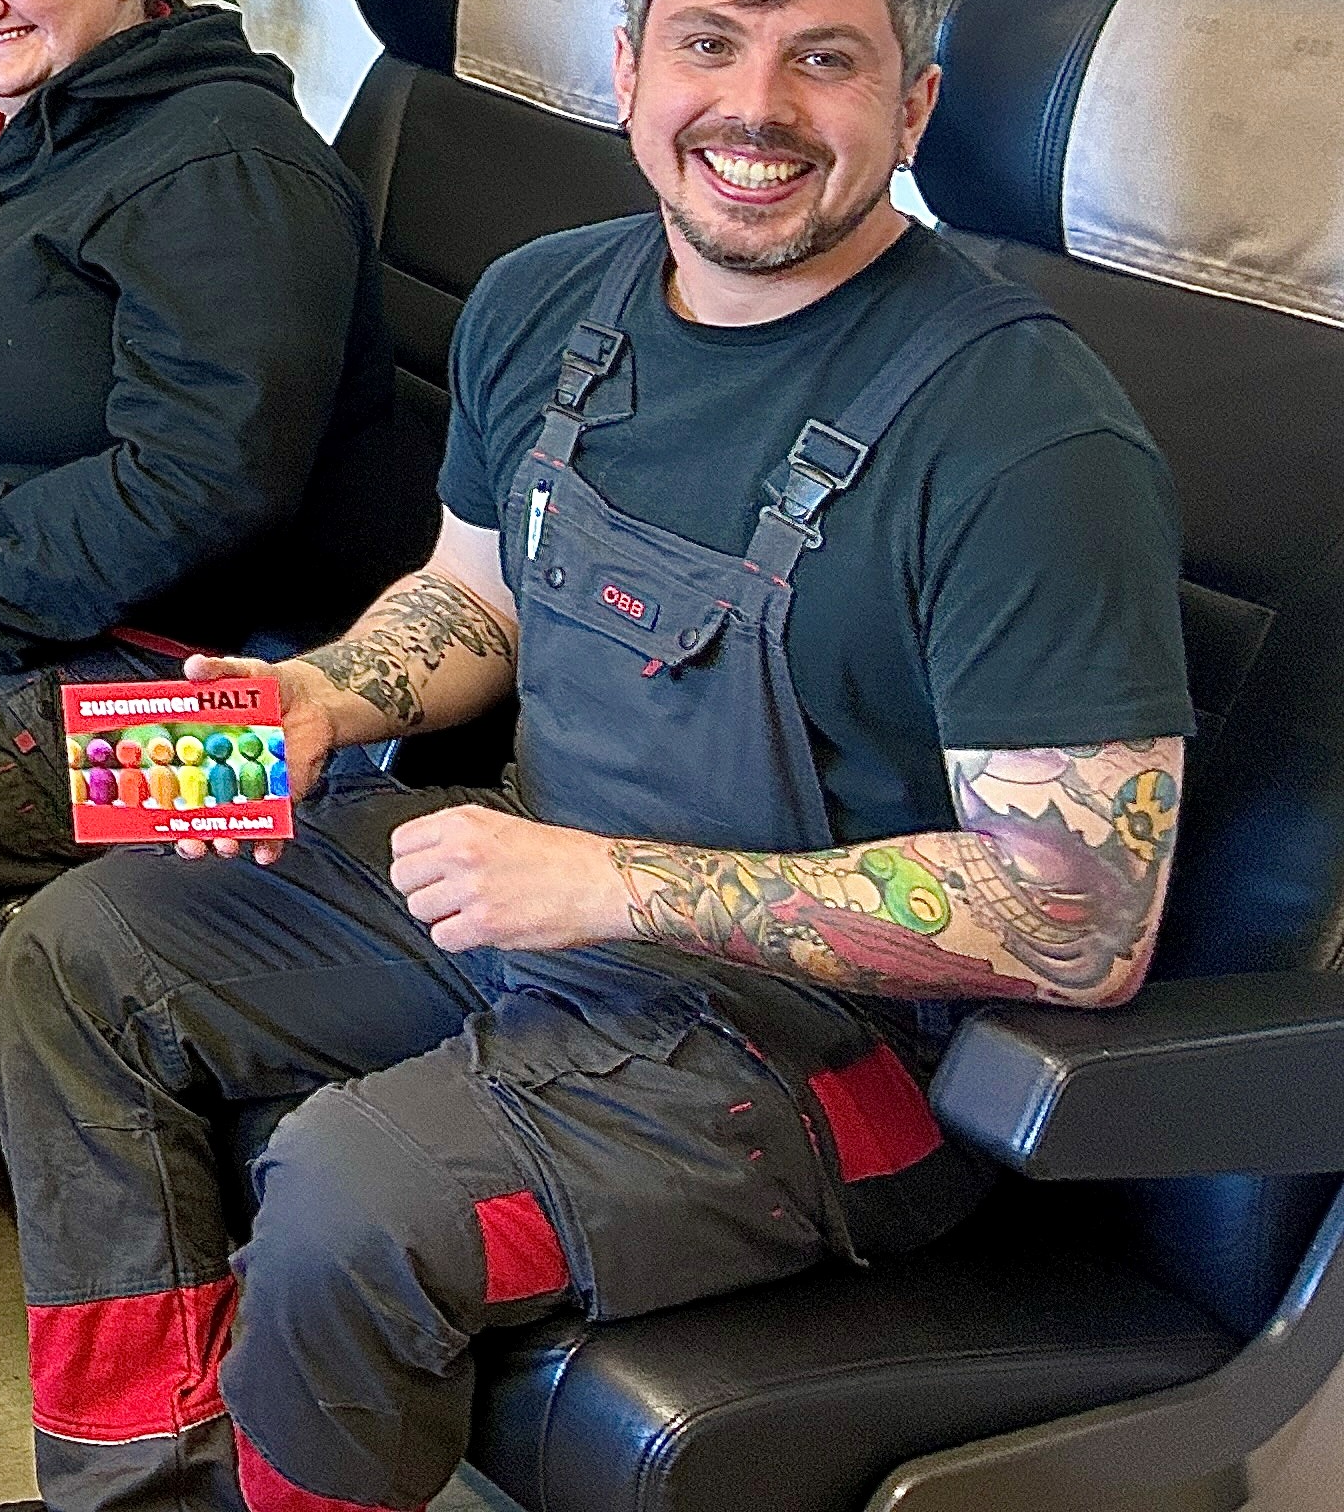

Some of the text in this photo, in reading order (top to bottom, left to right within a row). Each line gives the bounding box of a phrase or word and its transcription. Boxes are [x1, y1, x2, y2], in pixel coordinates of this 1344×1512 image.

[79, 689, 261, 717] zusammenHALT
[170, 818, 191, 831] für
[191, 817, 228, 830] GUTE
[229, 816, 274, 830] Arbeit!
